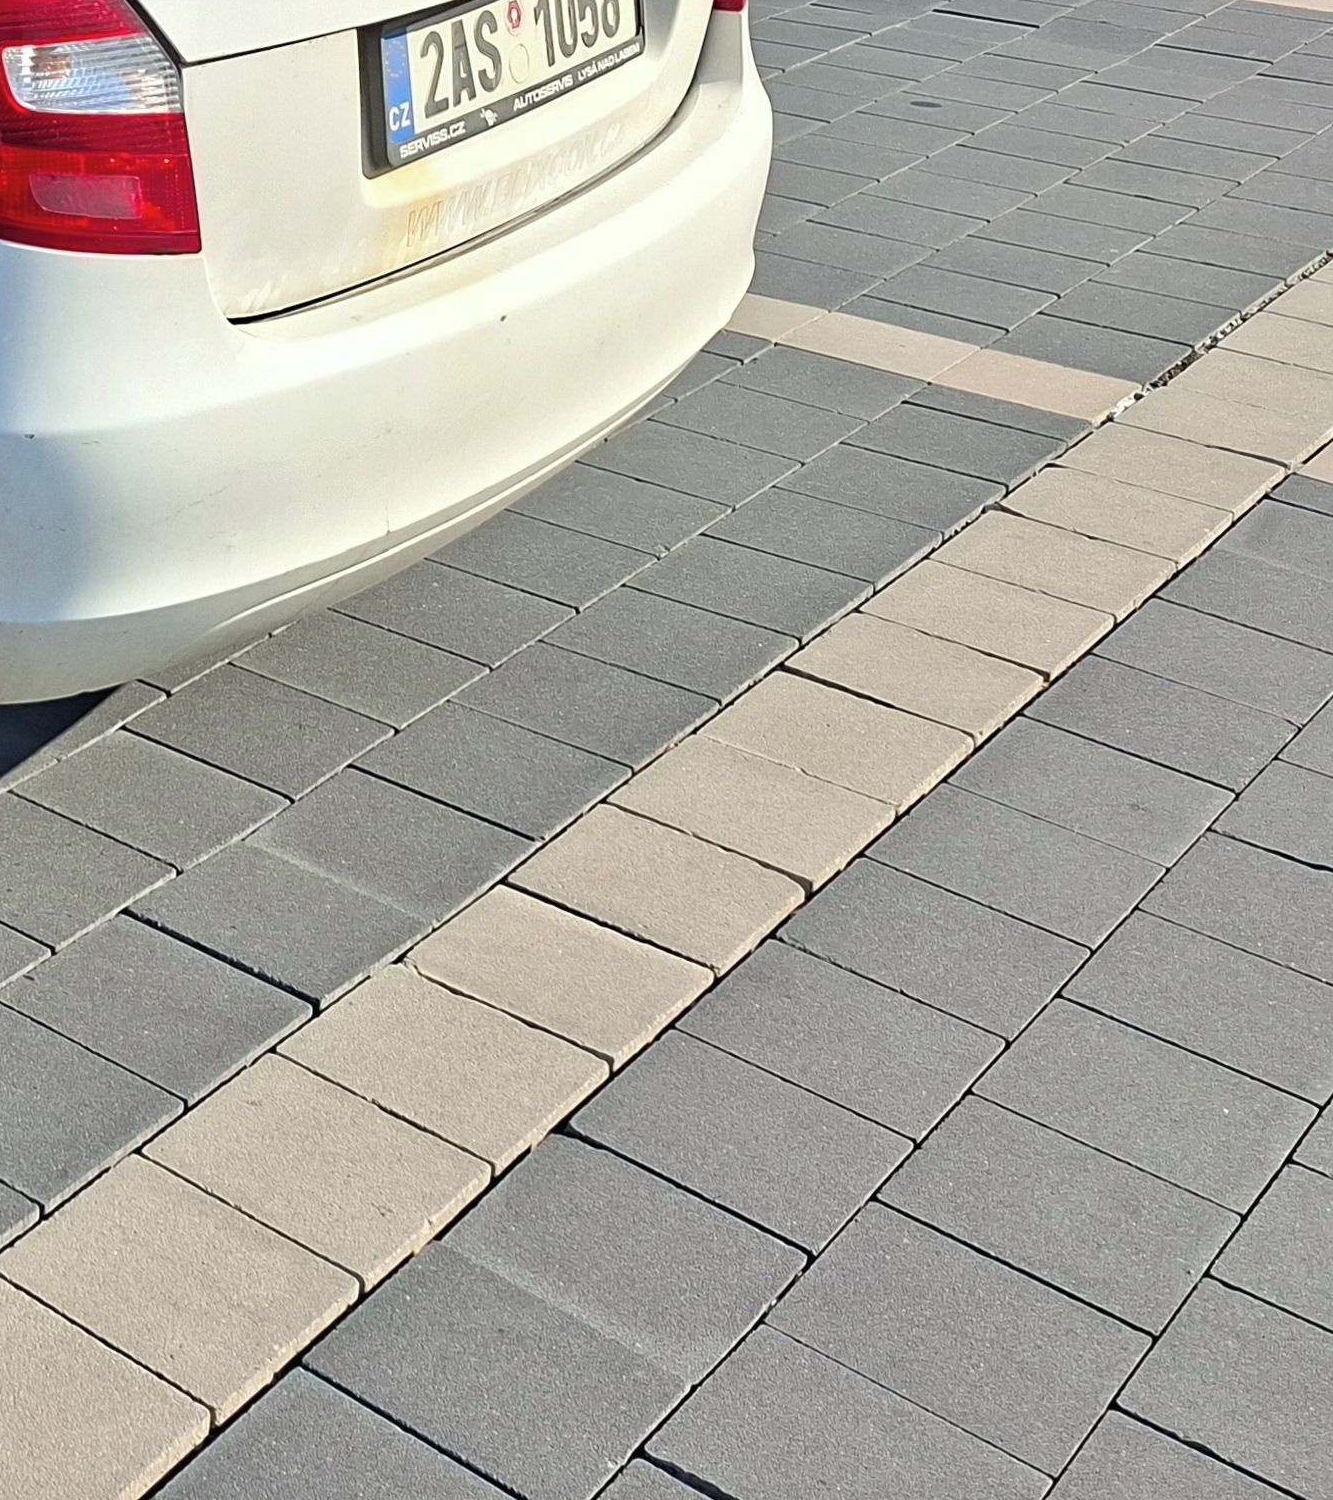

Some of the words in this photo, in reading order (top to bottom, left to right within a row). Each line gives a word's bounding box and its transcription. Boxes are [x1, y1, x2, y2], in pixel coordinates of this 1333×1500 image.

[420, 10, 502, 119] 2AS
[512, 73, 574, 113] AUTOSERVIS
[389, 101, 411, 132] CZ
